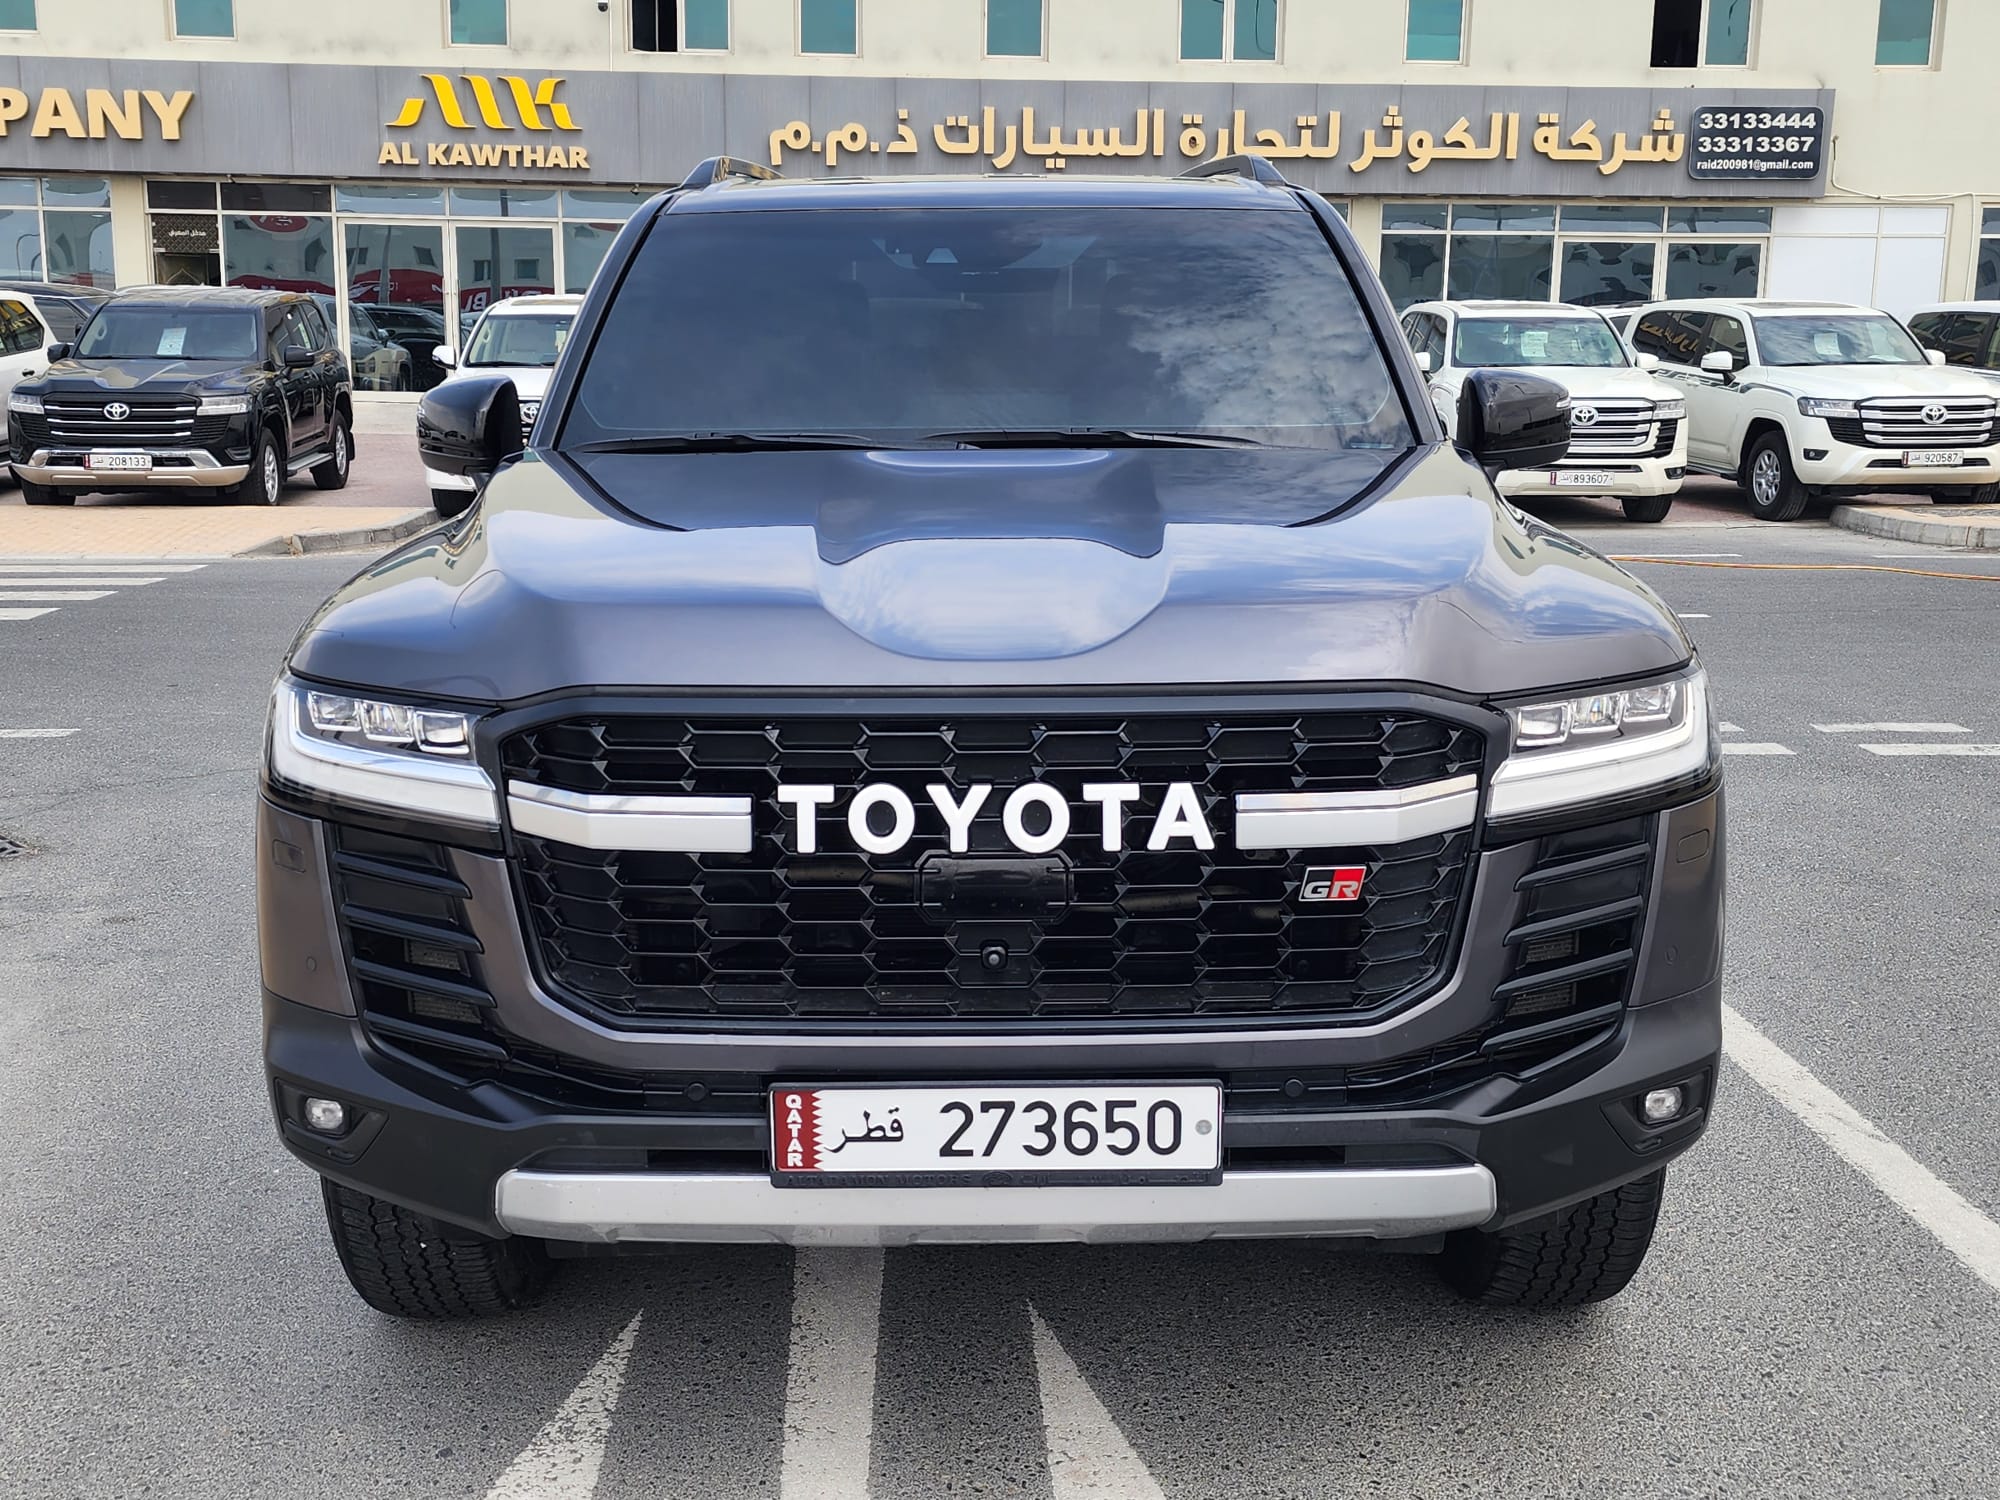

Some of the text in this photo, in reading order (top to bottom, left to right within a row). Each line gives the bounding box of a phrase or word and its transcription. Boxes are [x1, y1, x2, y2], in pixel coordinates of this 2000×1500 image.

[1698, 112, 1816, 130] 33133444
[932, 105, 1165, 169] السيارات
[1348, 105, 1520, 173] الكوثر
[1532, 108, 1686, 175] شركة
[1697, 135, 1815, 153] 33313367
[377, 141, 591, 169] AL KAWTHAR
[1696, 158, 1814, 171] raid200981@gmail.com
[108, 456, 146, 467] 208133
[1924, 452, 1959, 463] 920587
[1573, 473, 1609, 484] 893607
[776, 782, 1216, 855] TOYOTA
[1303, 880, 1359, 899] GR
[785, 1094, 804, 1168] QATAR
[824, 1099, 1183, 1158] قطر 273650
